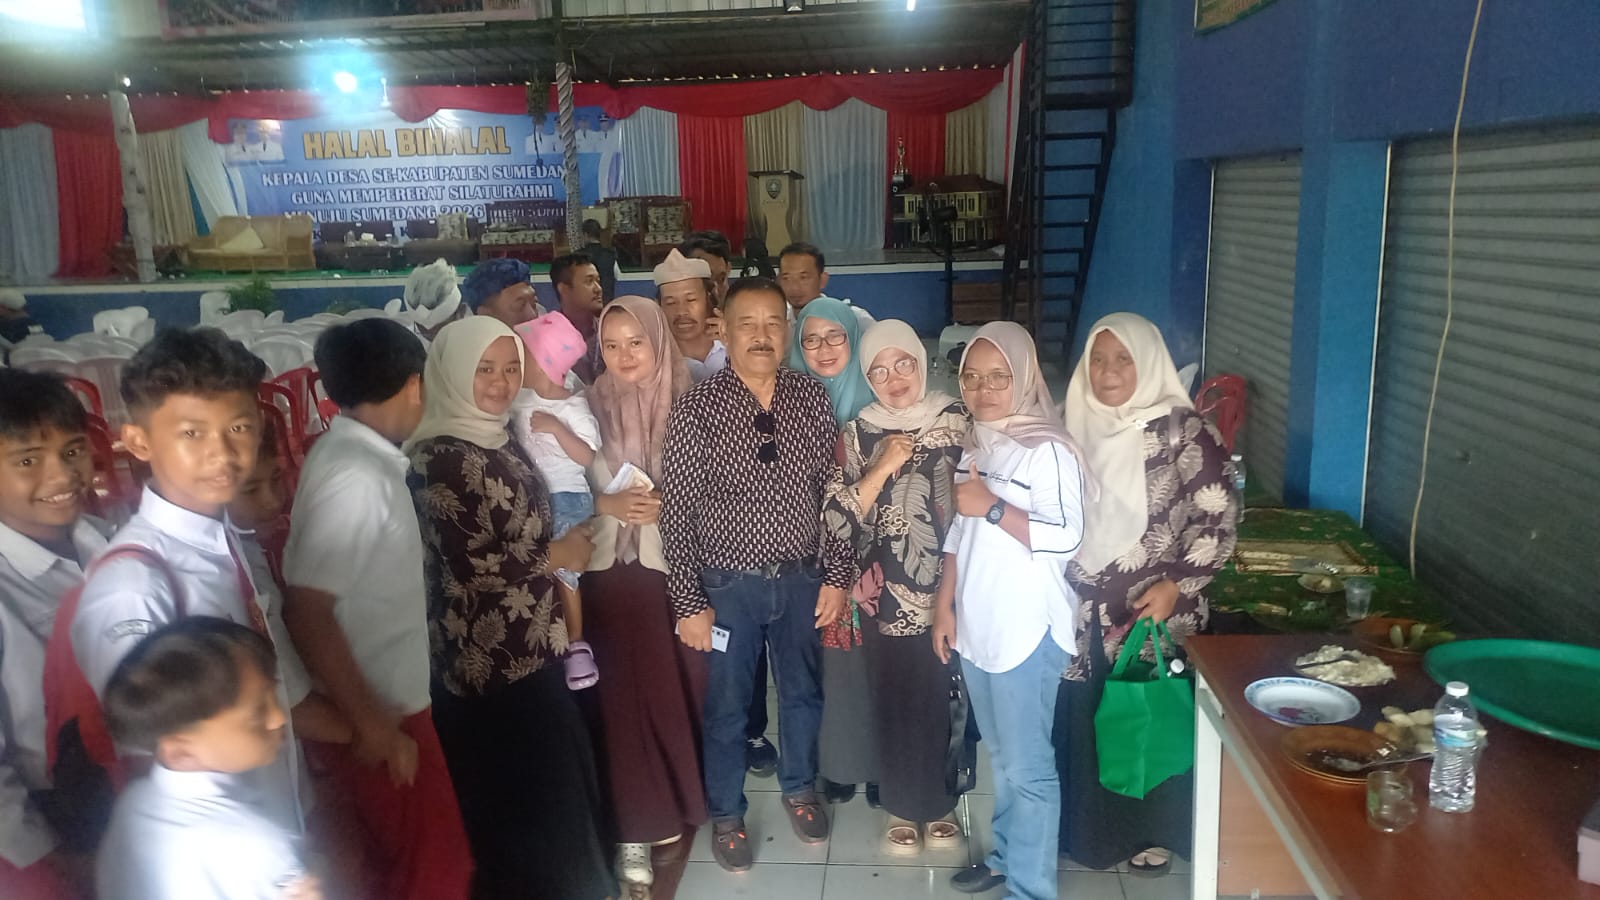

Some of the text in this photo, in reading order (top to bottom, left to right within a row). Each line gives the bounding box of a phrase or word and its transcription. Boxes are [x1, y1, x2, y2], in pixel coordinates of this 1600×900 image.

[303, 125, 511, 160] HALAL BIHALAL
[262, 164, 566, 187] KEPALA DESA SE-KABUPATEN SUMEDAN
[291, 184, 554, 205] GUNA MEMPERERAT SILATURAHMI
[351, 205, 437, 222] SUMEDANG
